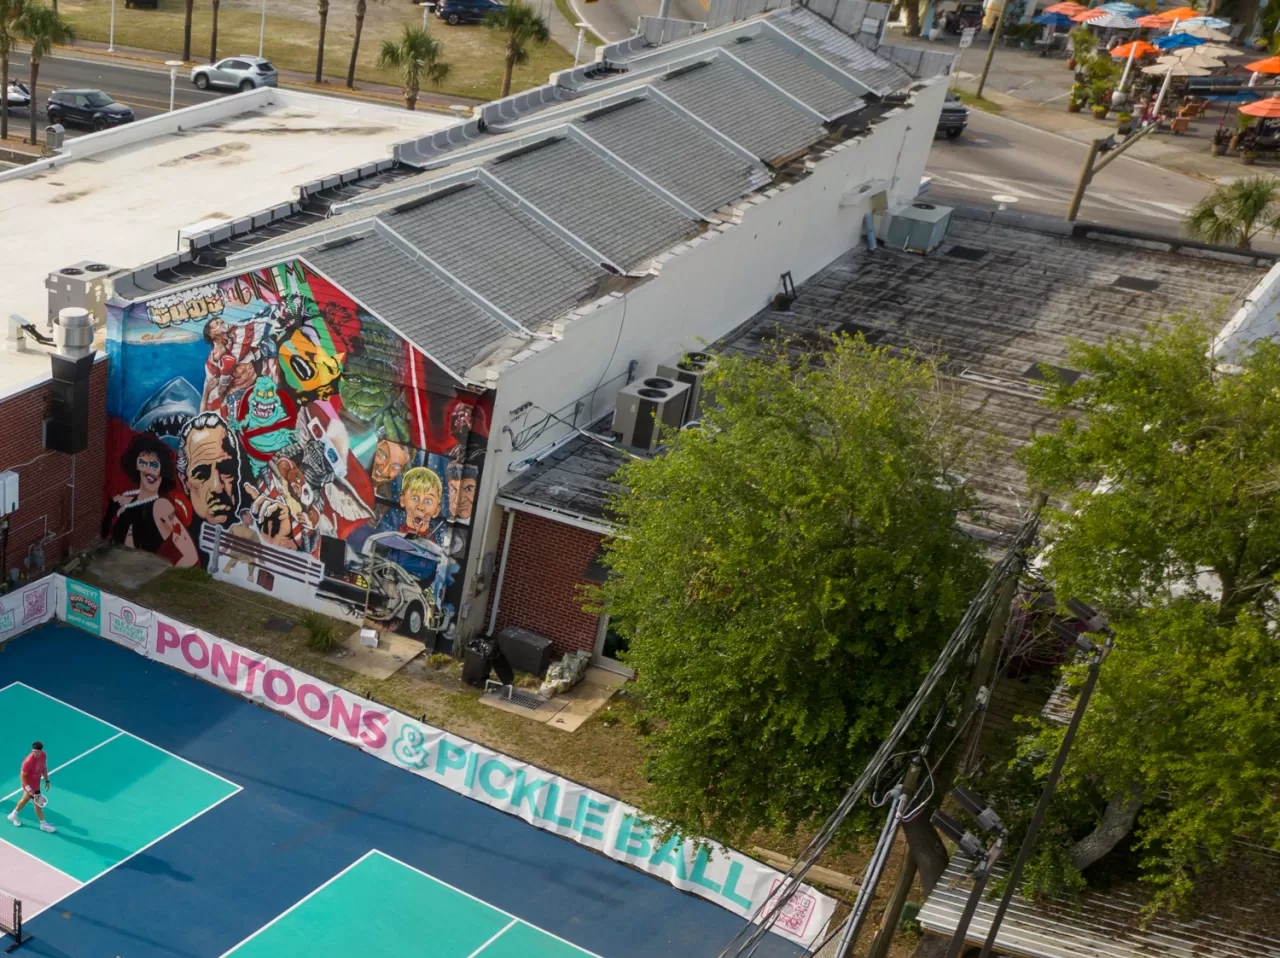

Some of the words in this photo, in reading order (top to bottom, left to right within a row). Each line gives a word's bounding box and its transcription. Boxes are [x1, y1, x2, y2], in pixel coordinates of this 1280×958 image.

[156, 620, 389, 749] PONTOONS
[392, 722, 429, 770] &
[434, 739, 610, 841] PICKLE
[614, 812, 753, 911] BALL
